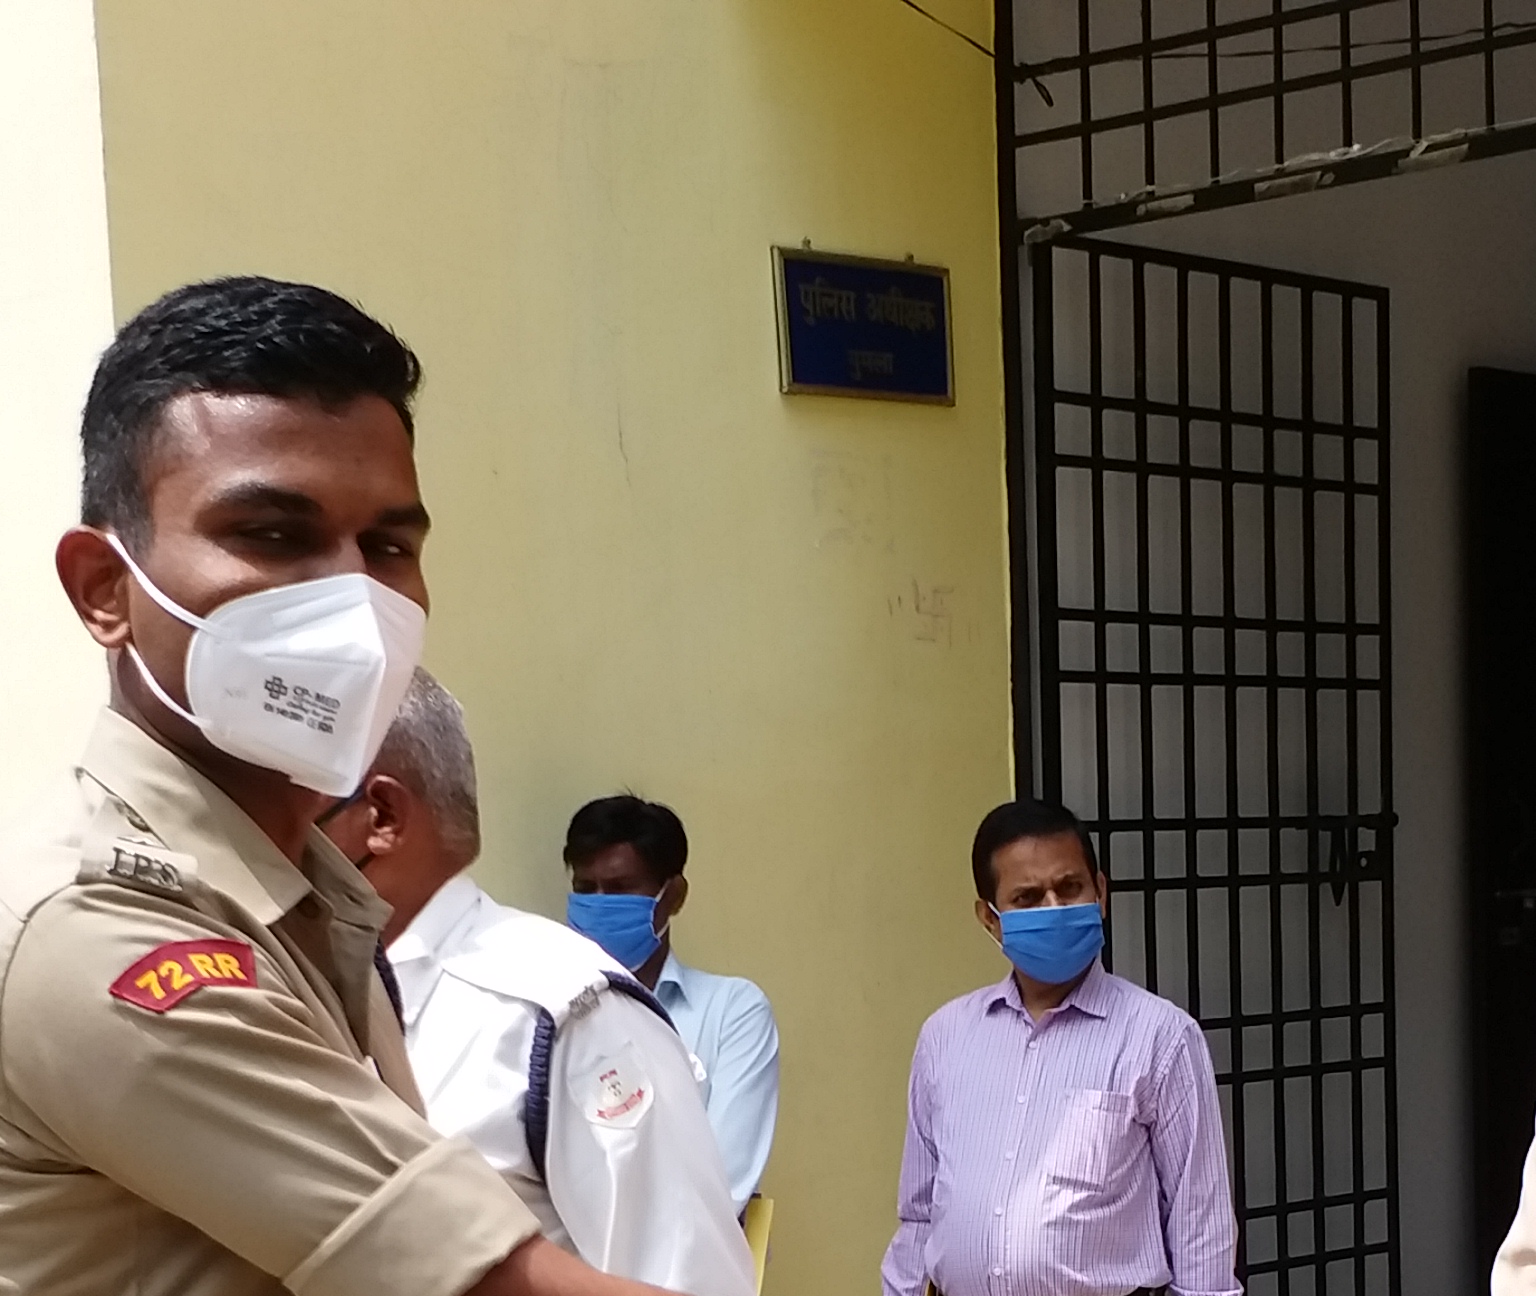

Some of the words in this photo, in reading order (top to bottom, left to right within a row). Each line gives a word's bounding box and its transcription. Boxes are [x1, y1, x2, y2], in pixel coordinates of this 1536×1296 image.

[798, 276, 856, 328] पुलिस
[135, 960, 195, 1000] 72
[188, 953, 249, 981] RR
